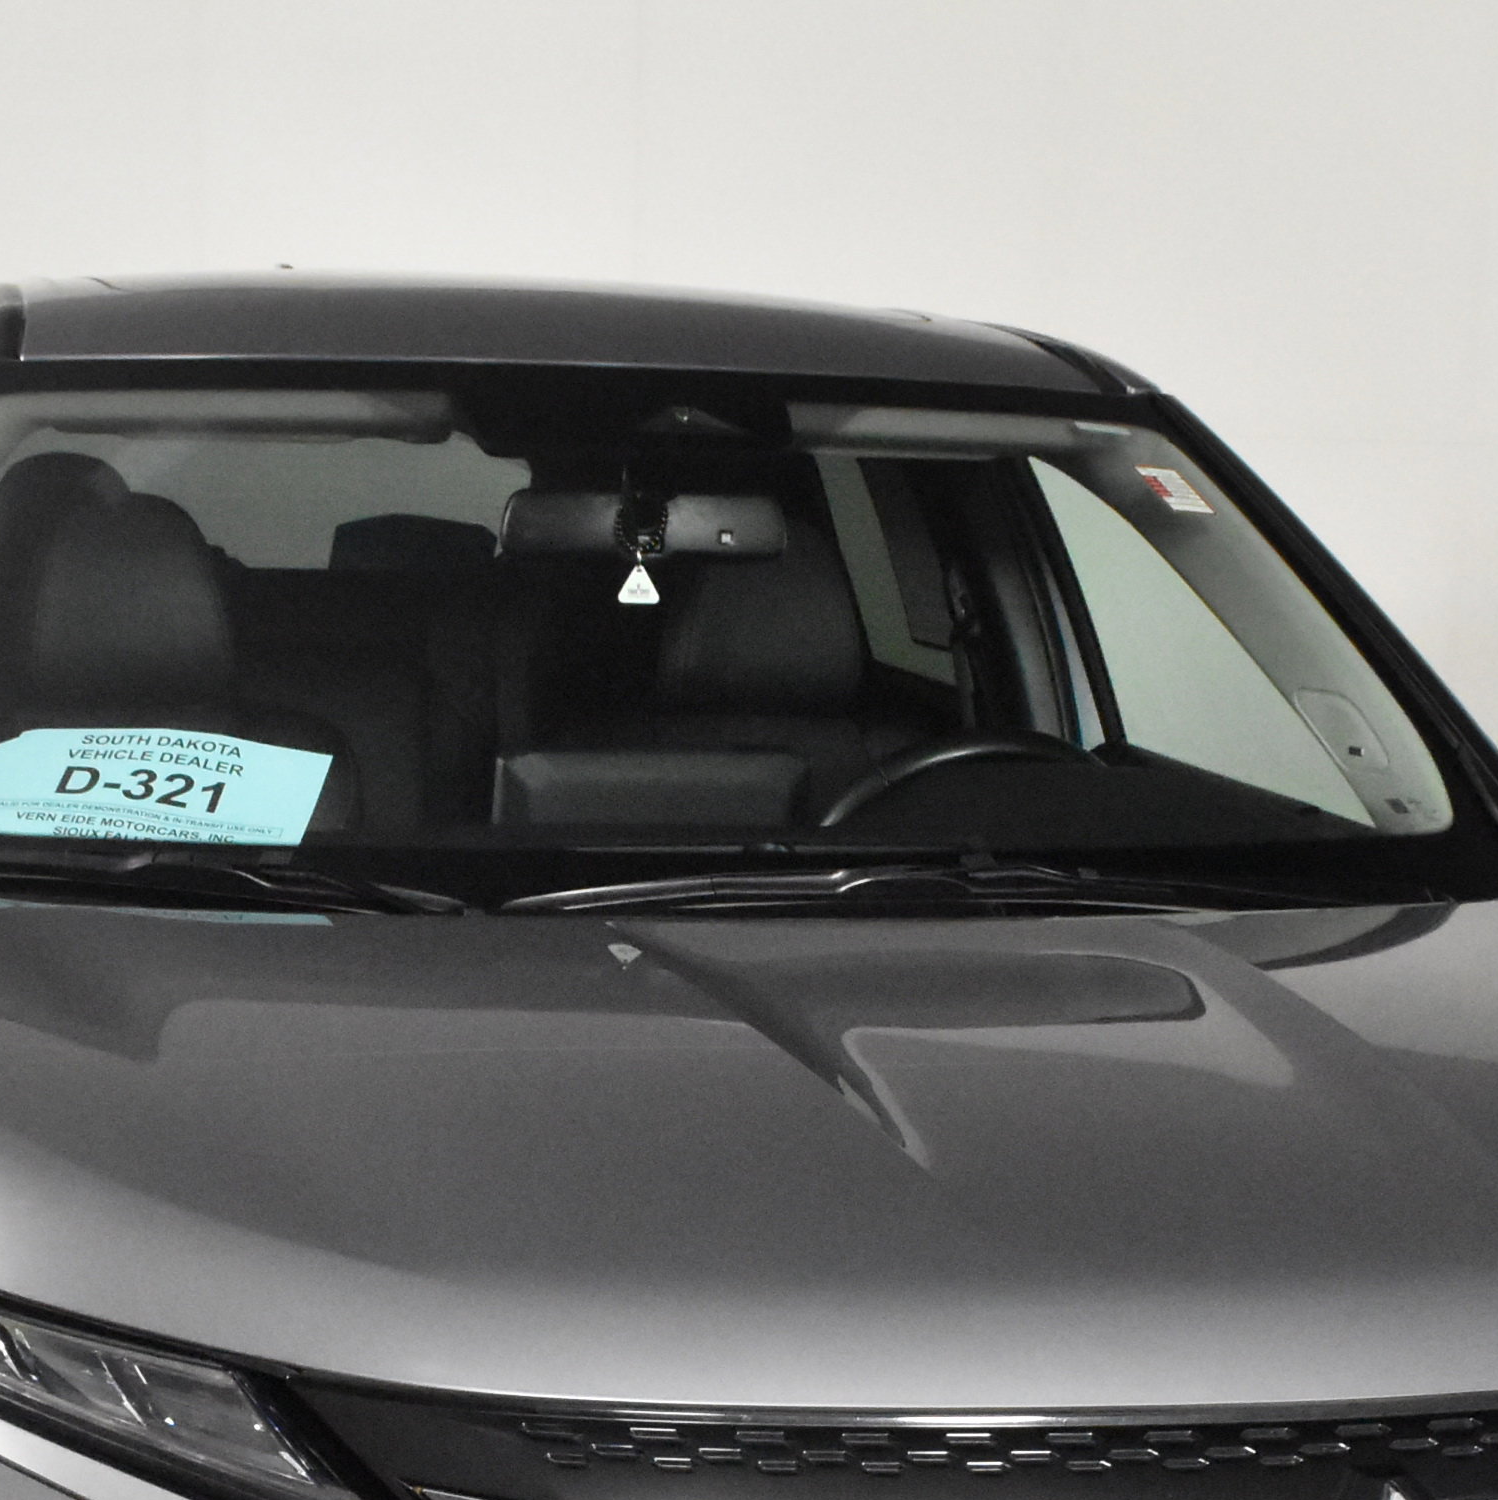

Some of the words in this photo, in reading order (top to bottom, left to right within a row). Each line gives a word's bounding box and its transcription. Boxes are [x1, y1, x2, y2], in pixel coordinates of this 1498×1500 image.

[82, 734, 152, 746] SOUTH
[157, 736, 242, 758] DAKOTA
[68, 749, 154, 761] VEHICLE
[159, 752, 244, 776] DEALER
[54, 765, 227, 814] D-321
[16, 811, 57, 822] VERN
[61, 814, 97, 825] EIDE
[81, 803, 161, 820] DEMONSTRATION
[52, 826, 100, 840] SIOUX
